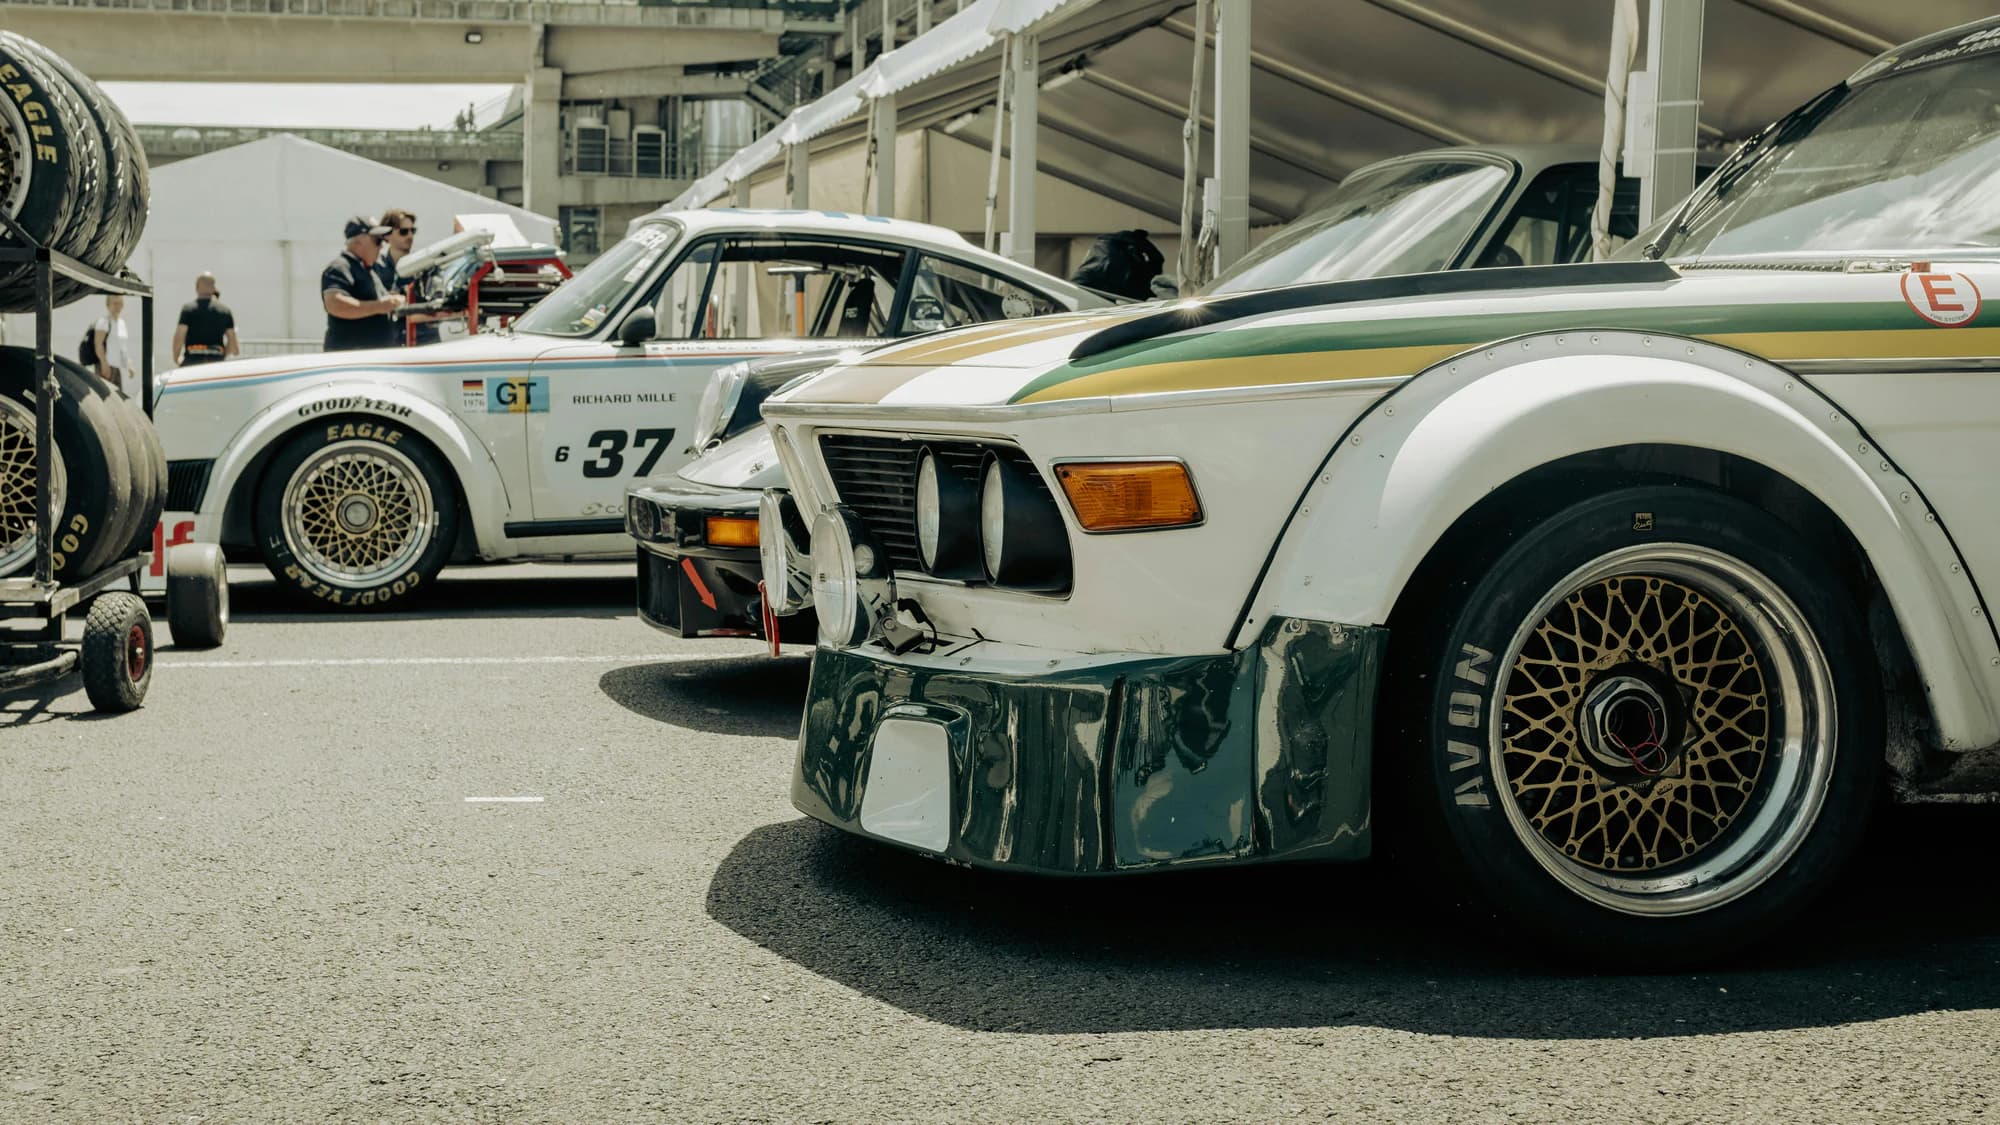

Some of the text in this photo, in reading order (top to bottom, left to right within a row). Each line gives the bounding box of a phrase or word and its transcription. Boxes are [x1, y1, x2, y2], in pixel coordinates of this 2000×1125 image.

[0, 63, 58, 164] EAGLE
[1919, 275, 1965, 311] E
[496, 382, 537, 406] GT
[573, 392, 677, 405] RICHARD MILLE
[327, 423, 403, 445] EAGLE
[555, 428, 676, 478] 6 37
[1447, 643, 1494, 810] AVON
